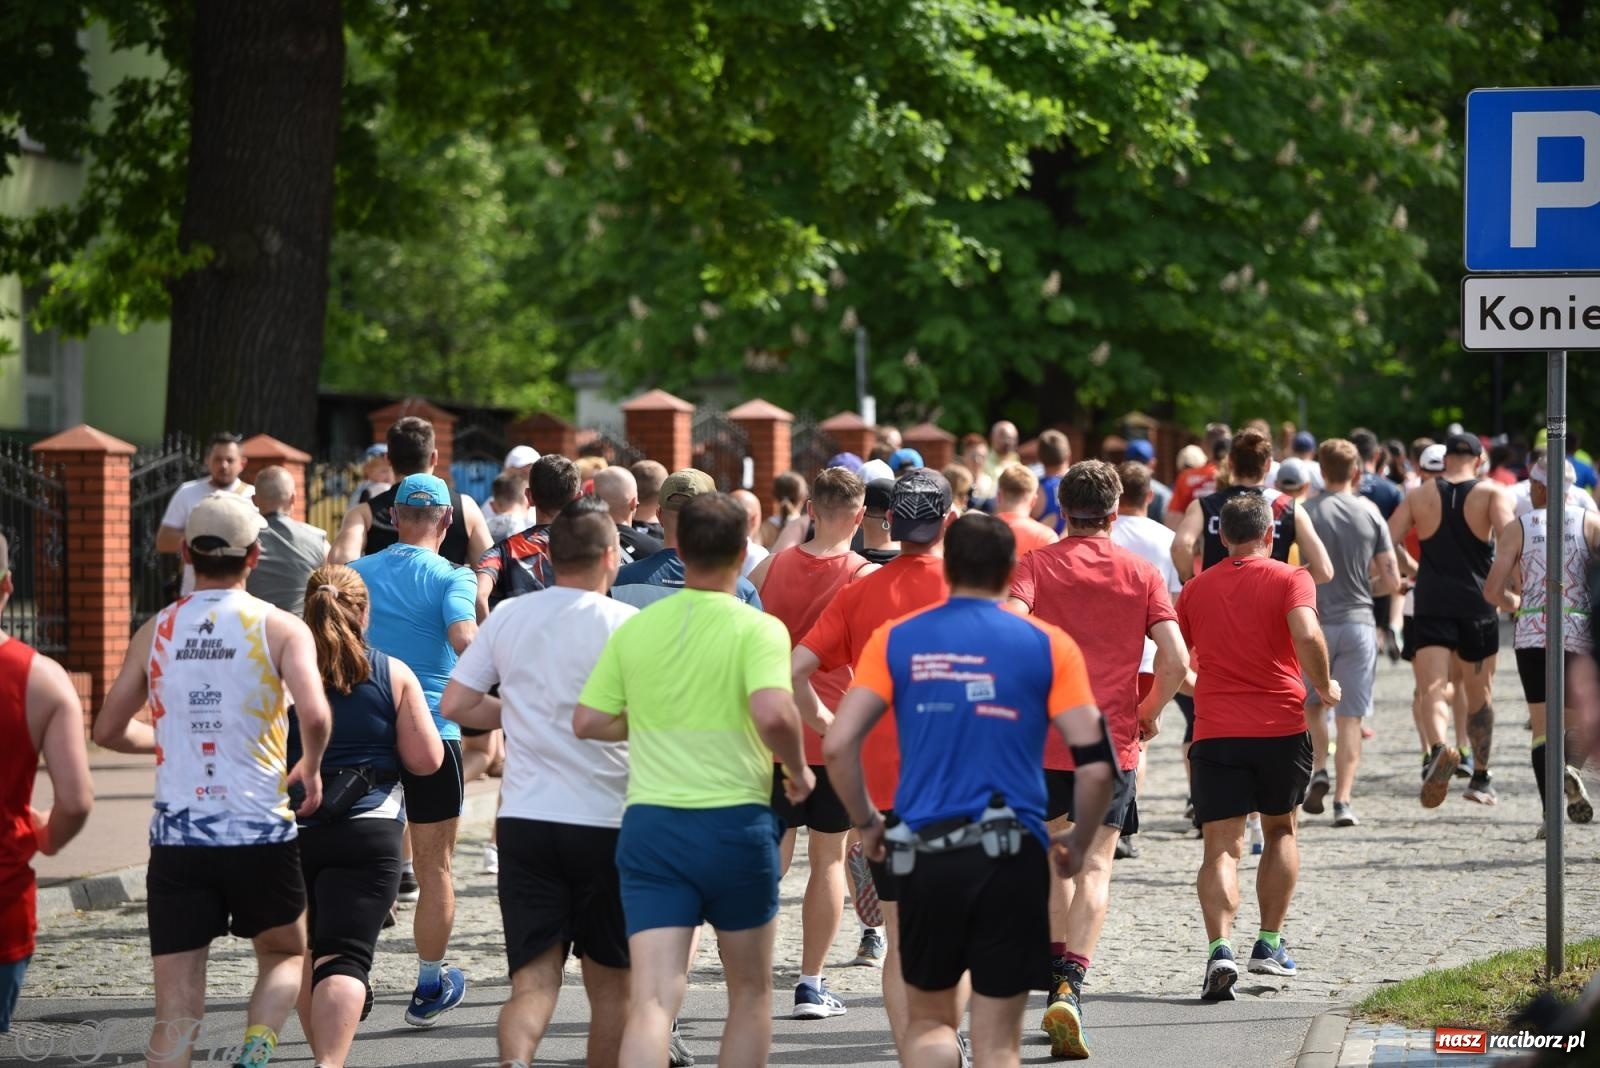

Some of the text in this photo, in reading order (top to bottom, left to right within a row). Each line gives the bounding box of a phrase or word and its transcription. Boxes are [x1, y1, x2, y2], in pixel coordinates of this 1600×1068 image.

[1510, 111, 1600, 248] P
[1479, 295, 1600, 331] Konie
[201, 638, 223, 648] BIEG
[191, 721, 210, 729] XYZ
